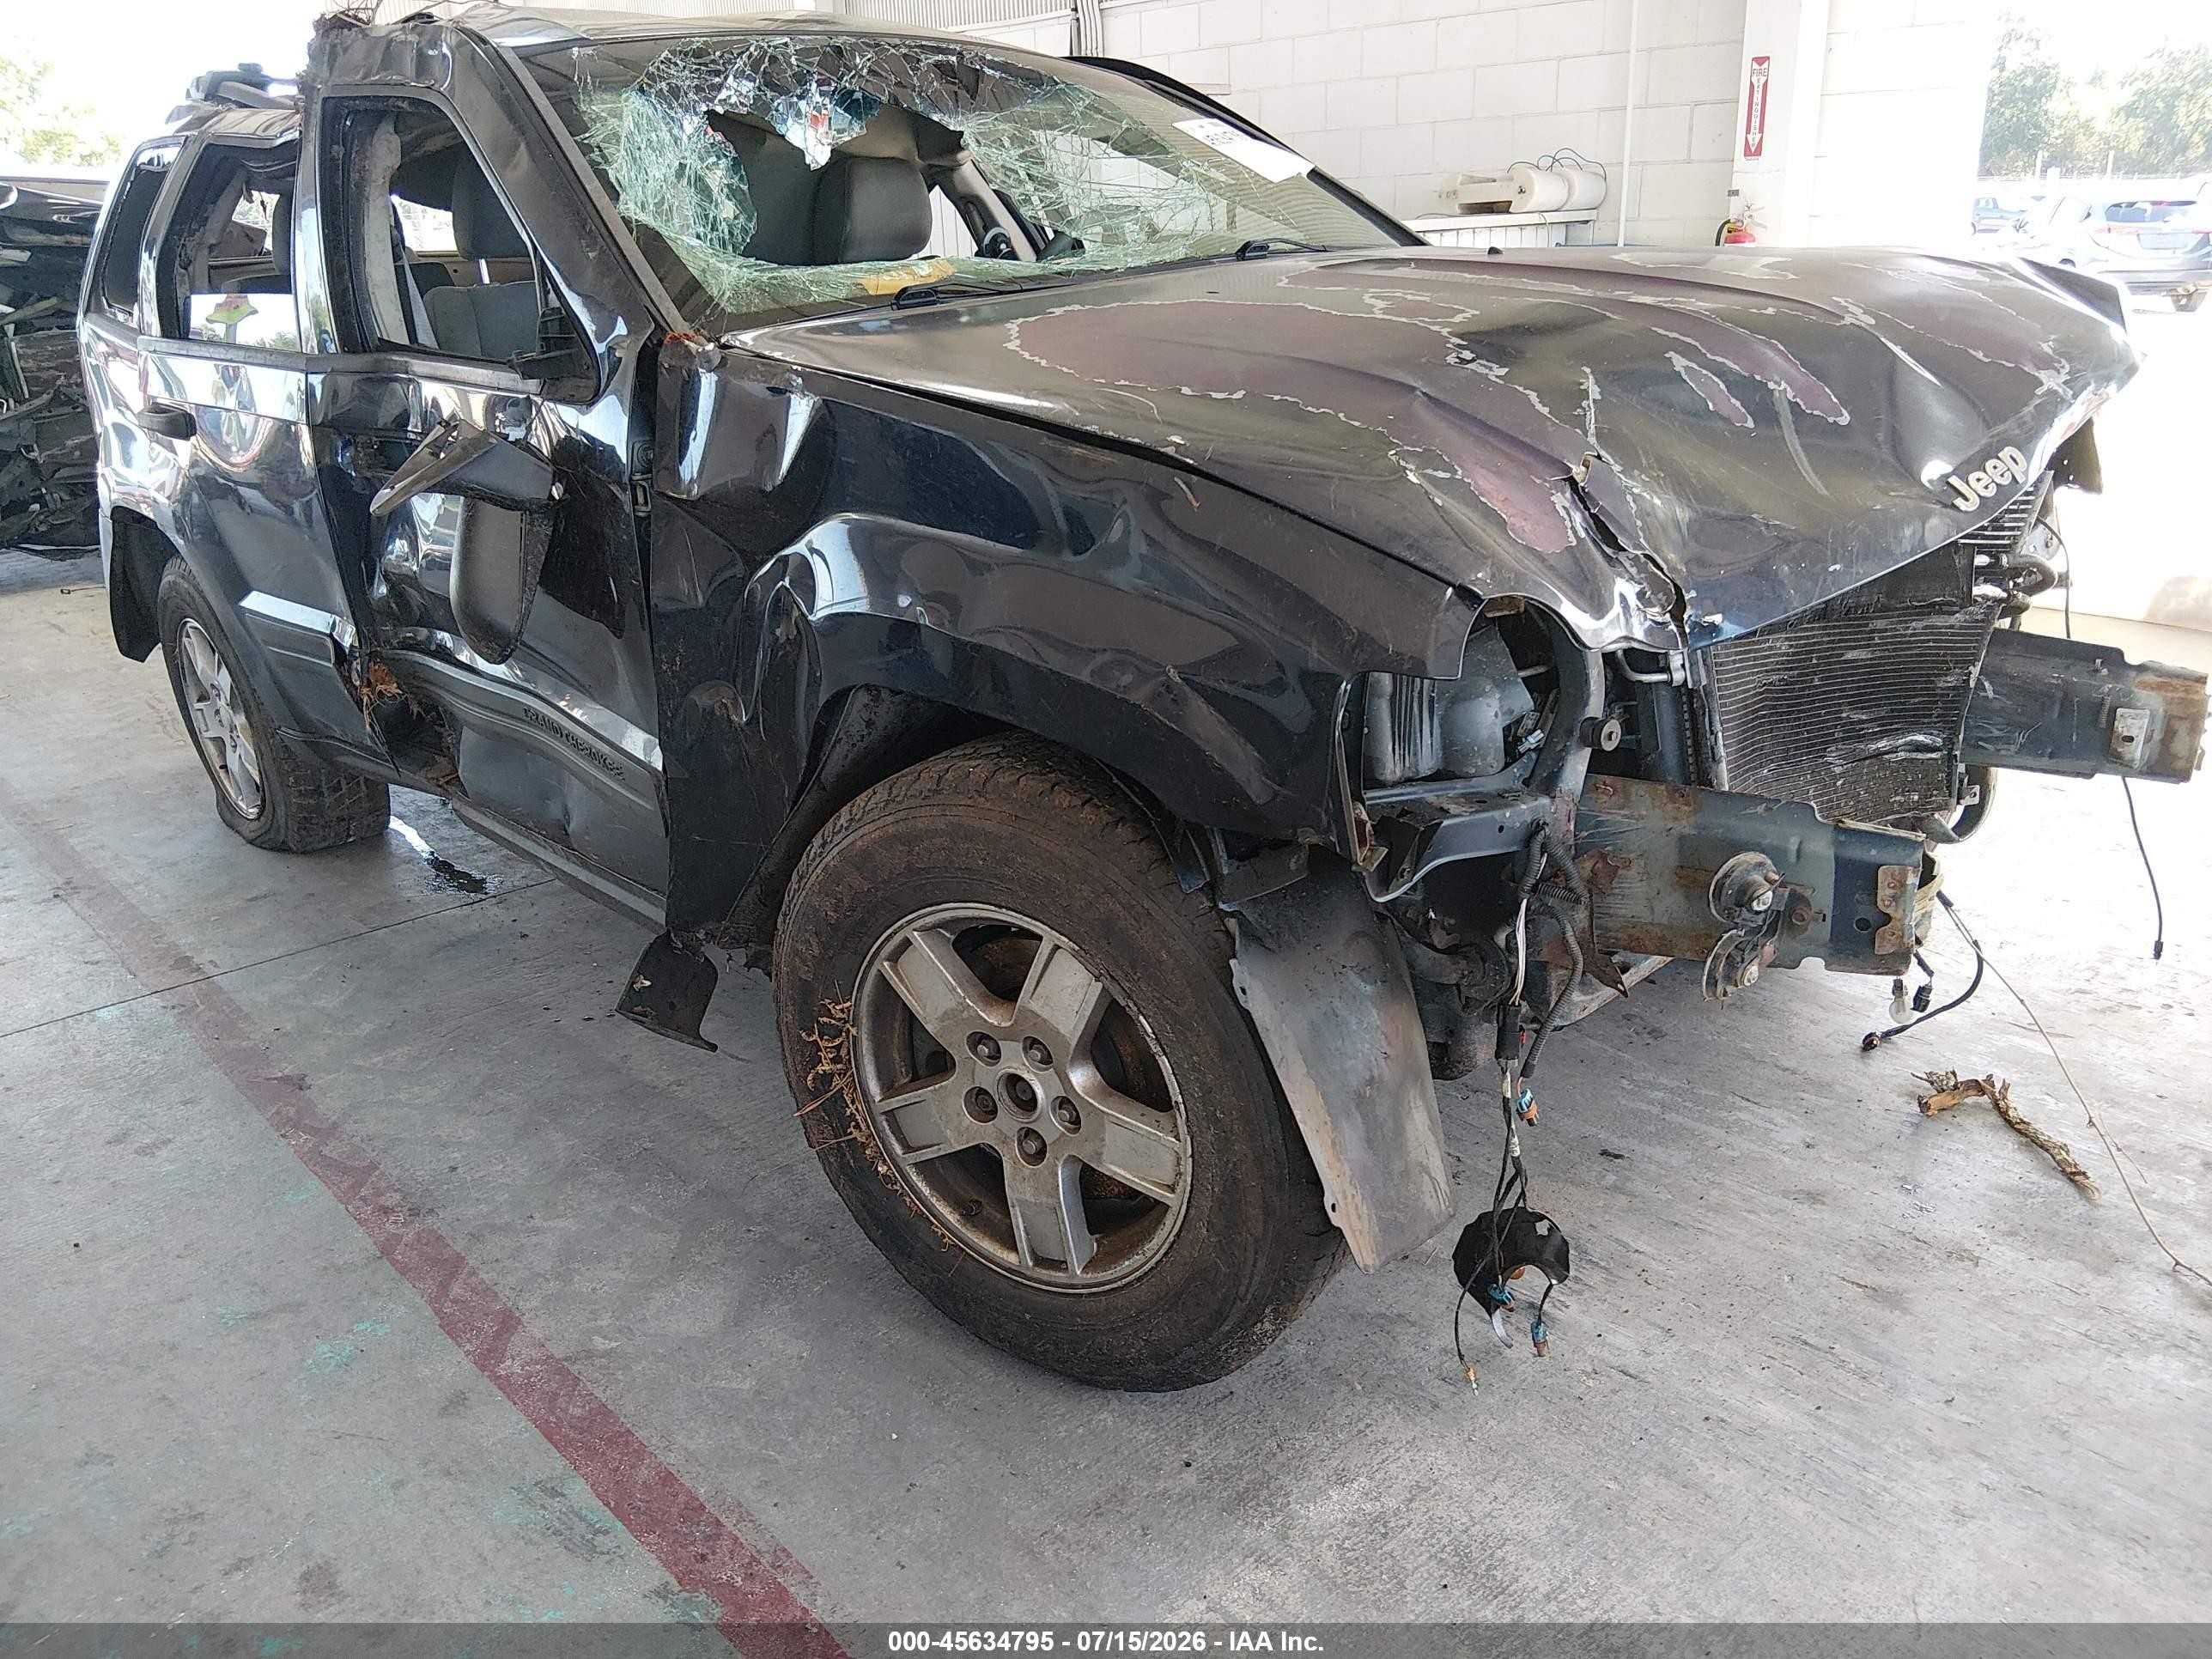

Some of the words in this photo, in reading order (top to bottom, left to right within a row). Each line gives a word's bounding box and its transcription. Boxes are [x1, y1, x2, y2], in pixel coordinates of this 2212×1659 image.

[1752, 68, 1768, 77] FIRE
[1751, 77, 1761, 148] EXTINGUISHER
[1947, 446, 2027, 512] Jeep
[565, 730, 626, 781] CHEROKEE
